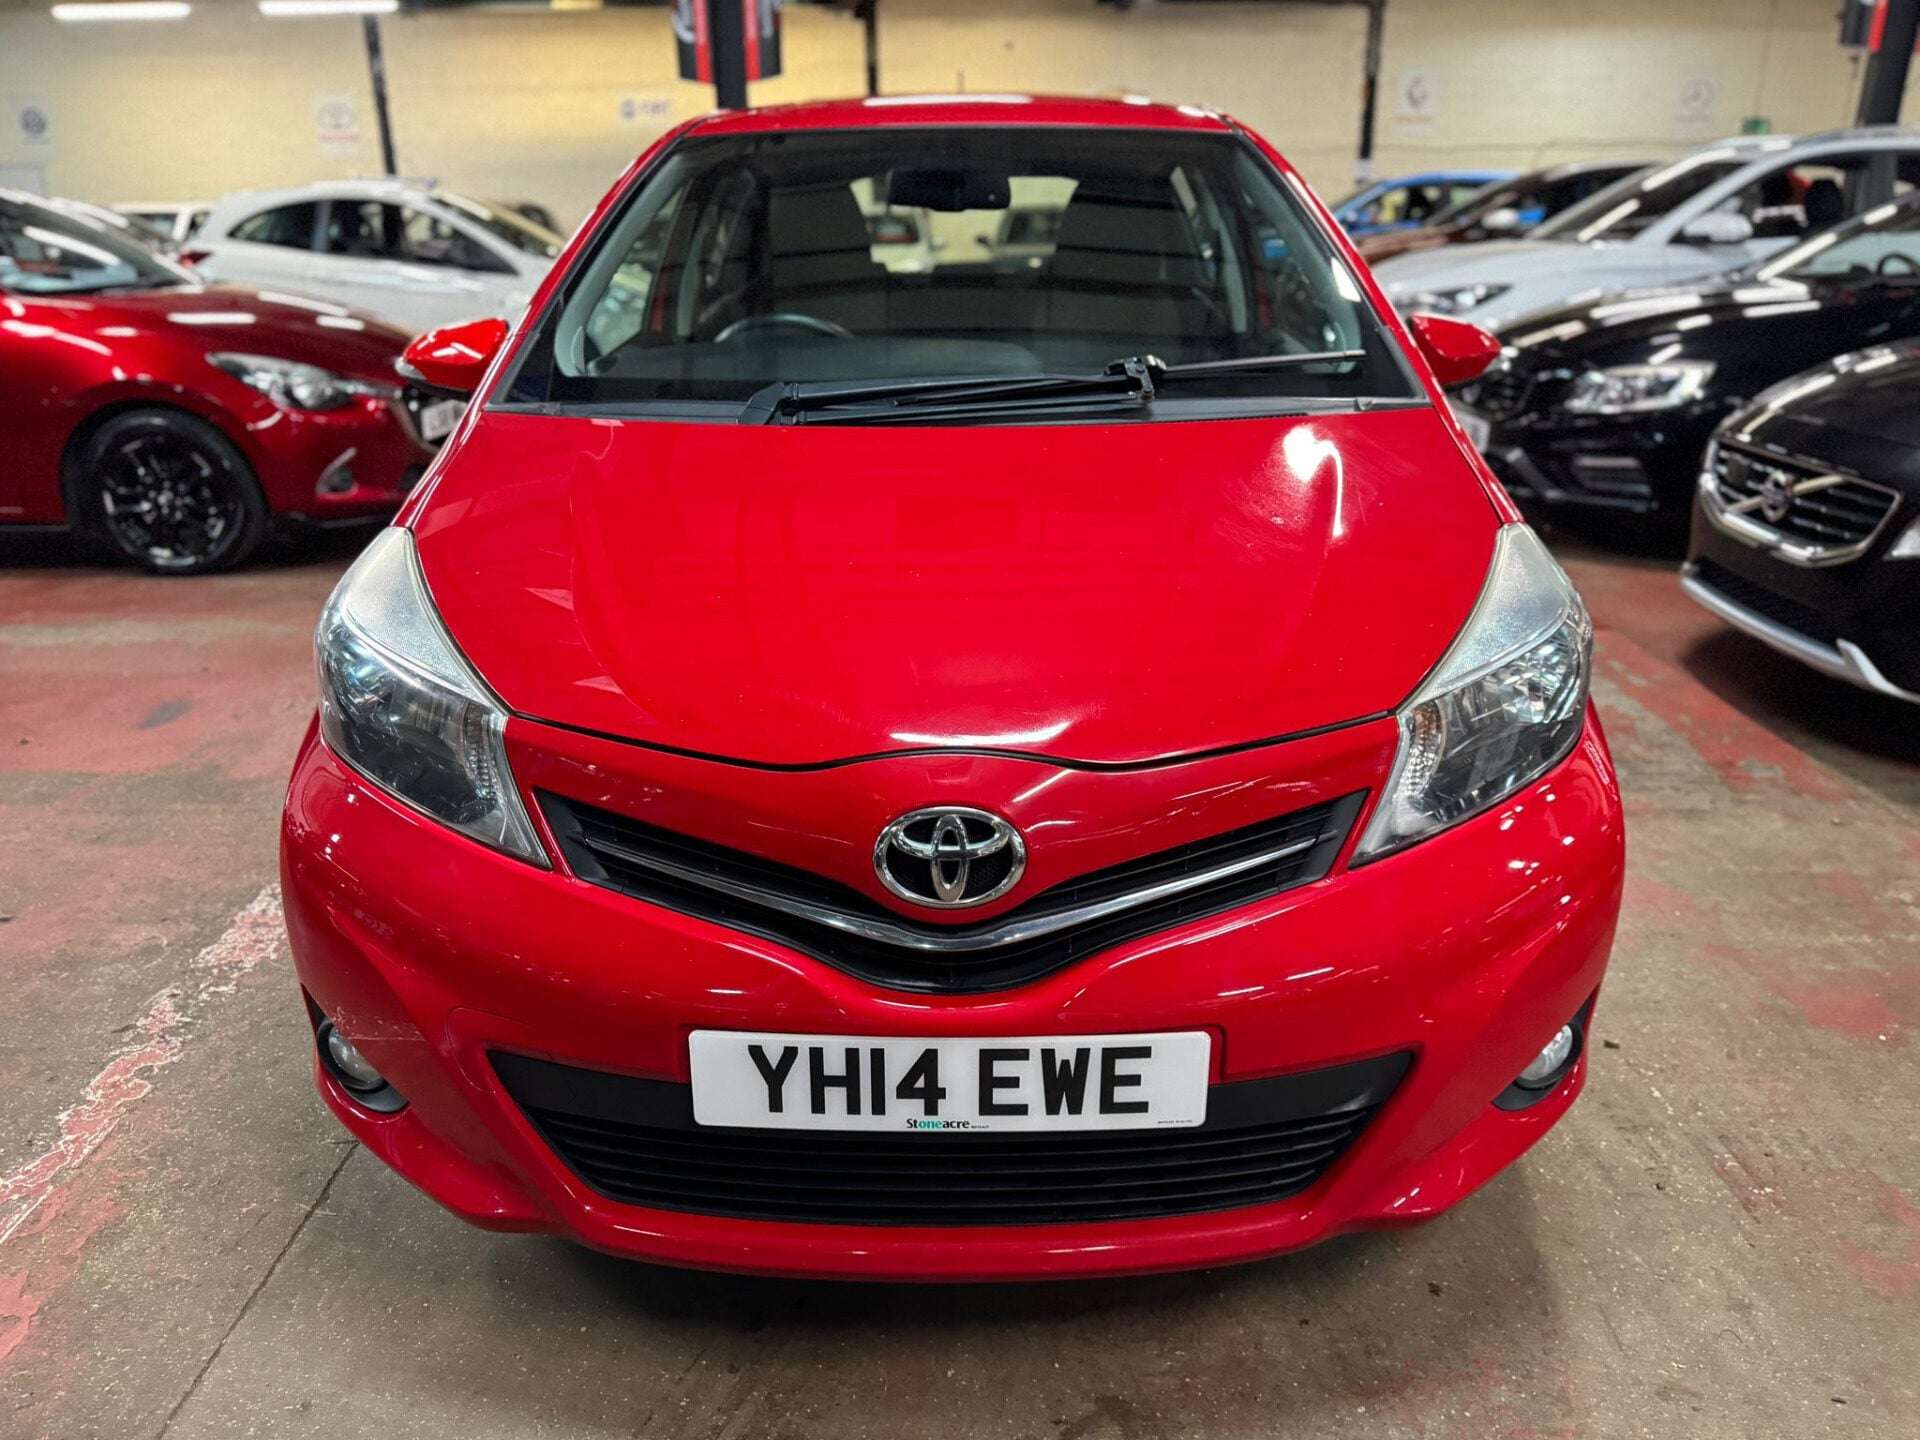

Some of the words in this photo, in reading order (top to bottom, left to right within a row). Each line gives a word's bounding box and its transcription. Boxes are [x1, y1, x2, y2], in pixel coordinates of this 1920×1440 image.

[747, 1044, 947, 1116] YH14
[978, 1045, 1153, 1116] EWE
[906, 1118, 971, 1129] Stoneacre
